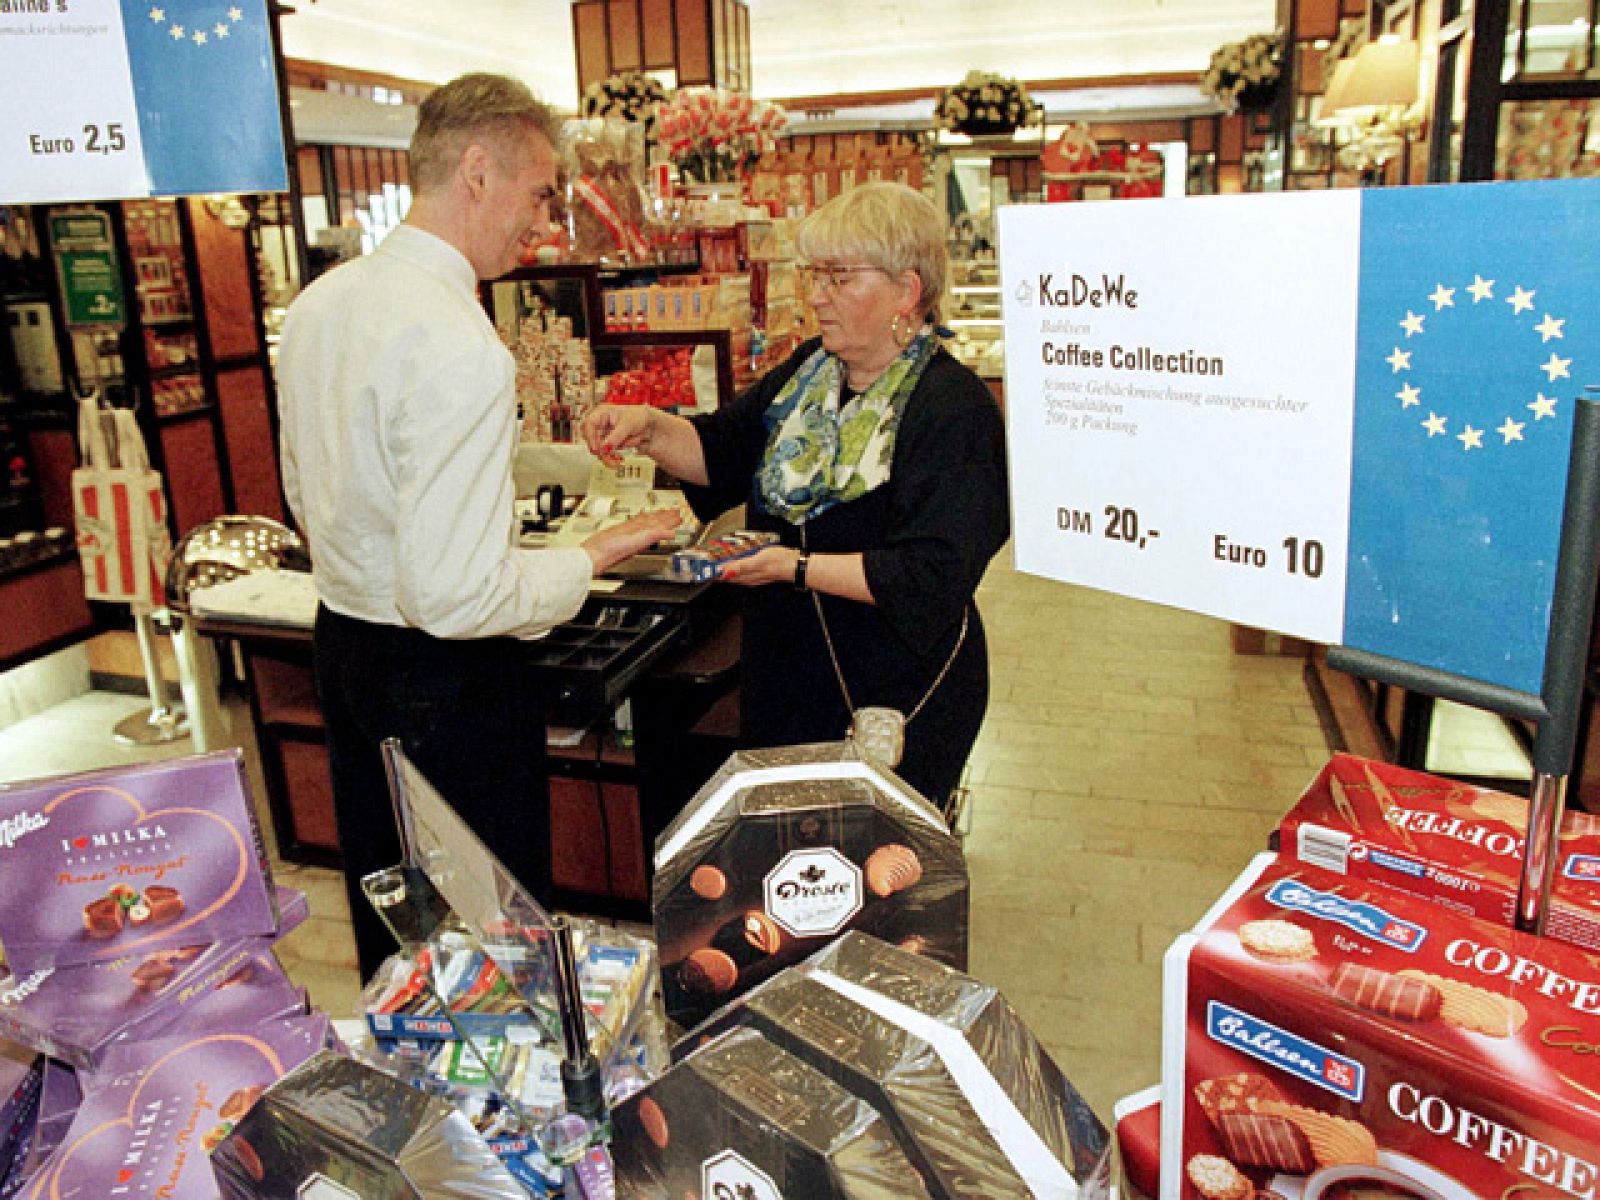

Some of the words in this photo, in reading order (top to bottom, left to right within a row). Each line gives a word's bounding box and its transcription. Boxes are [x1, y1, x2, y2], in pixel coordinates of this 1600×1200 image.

[29, 134, 75, 153] Euro
[83, 123, 125, 155] 2,5
[1039, 273, 1138, 308] KaDeWe
[1041, 341, 1104, 368] Coffee
[1109, 345, 1224, 376] Collection
[1057, 507, 1092, 535] DM
[1213, 534, 1267, 568] Euro
[1282, 536, 1324, 579] 10
[92, 824, 166, 848] MILKA
[1216, 1013, 1322, 1075] Bahlsen
[1387, 1080, 1600, 1200] COFFEE
